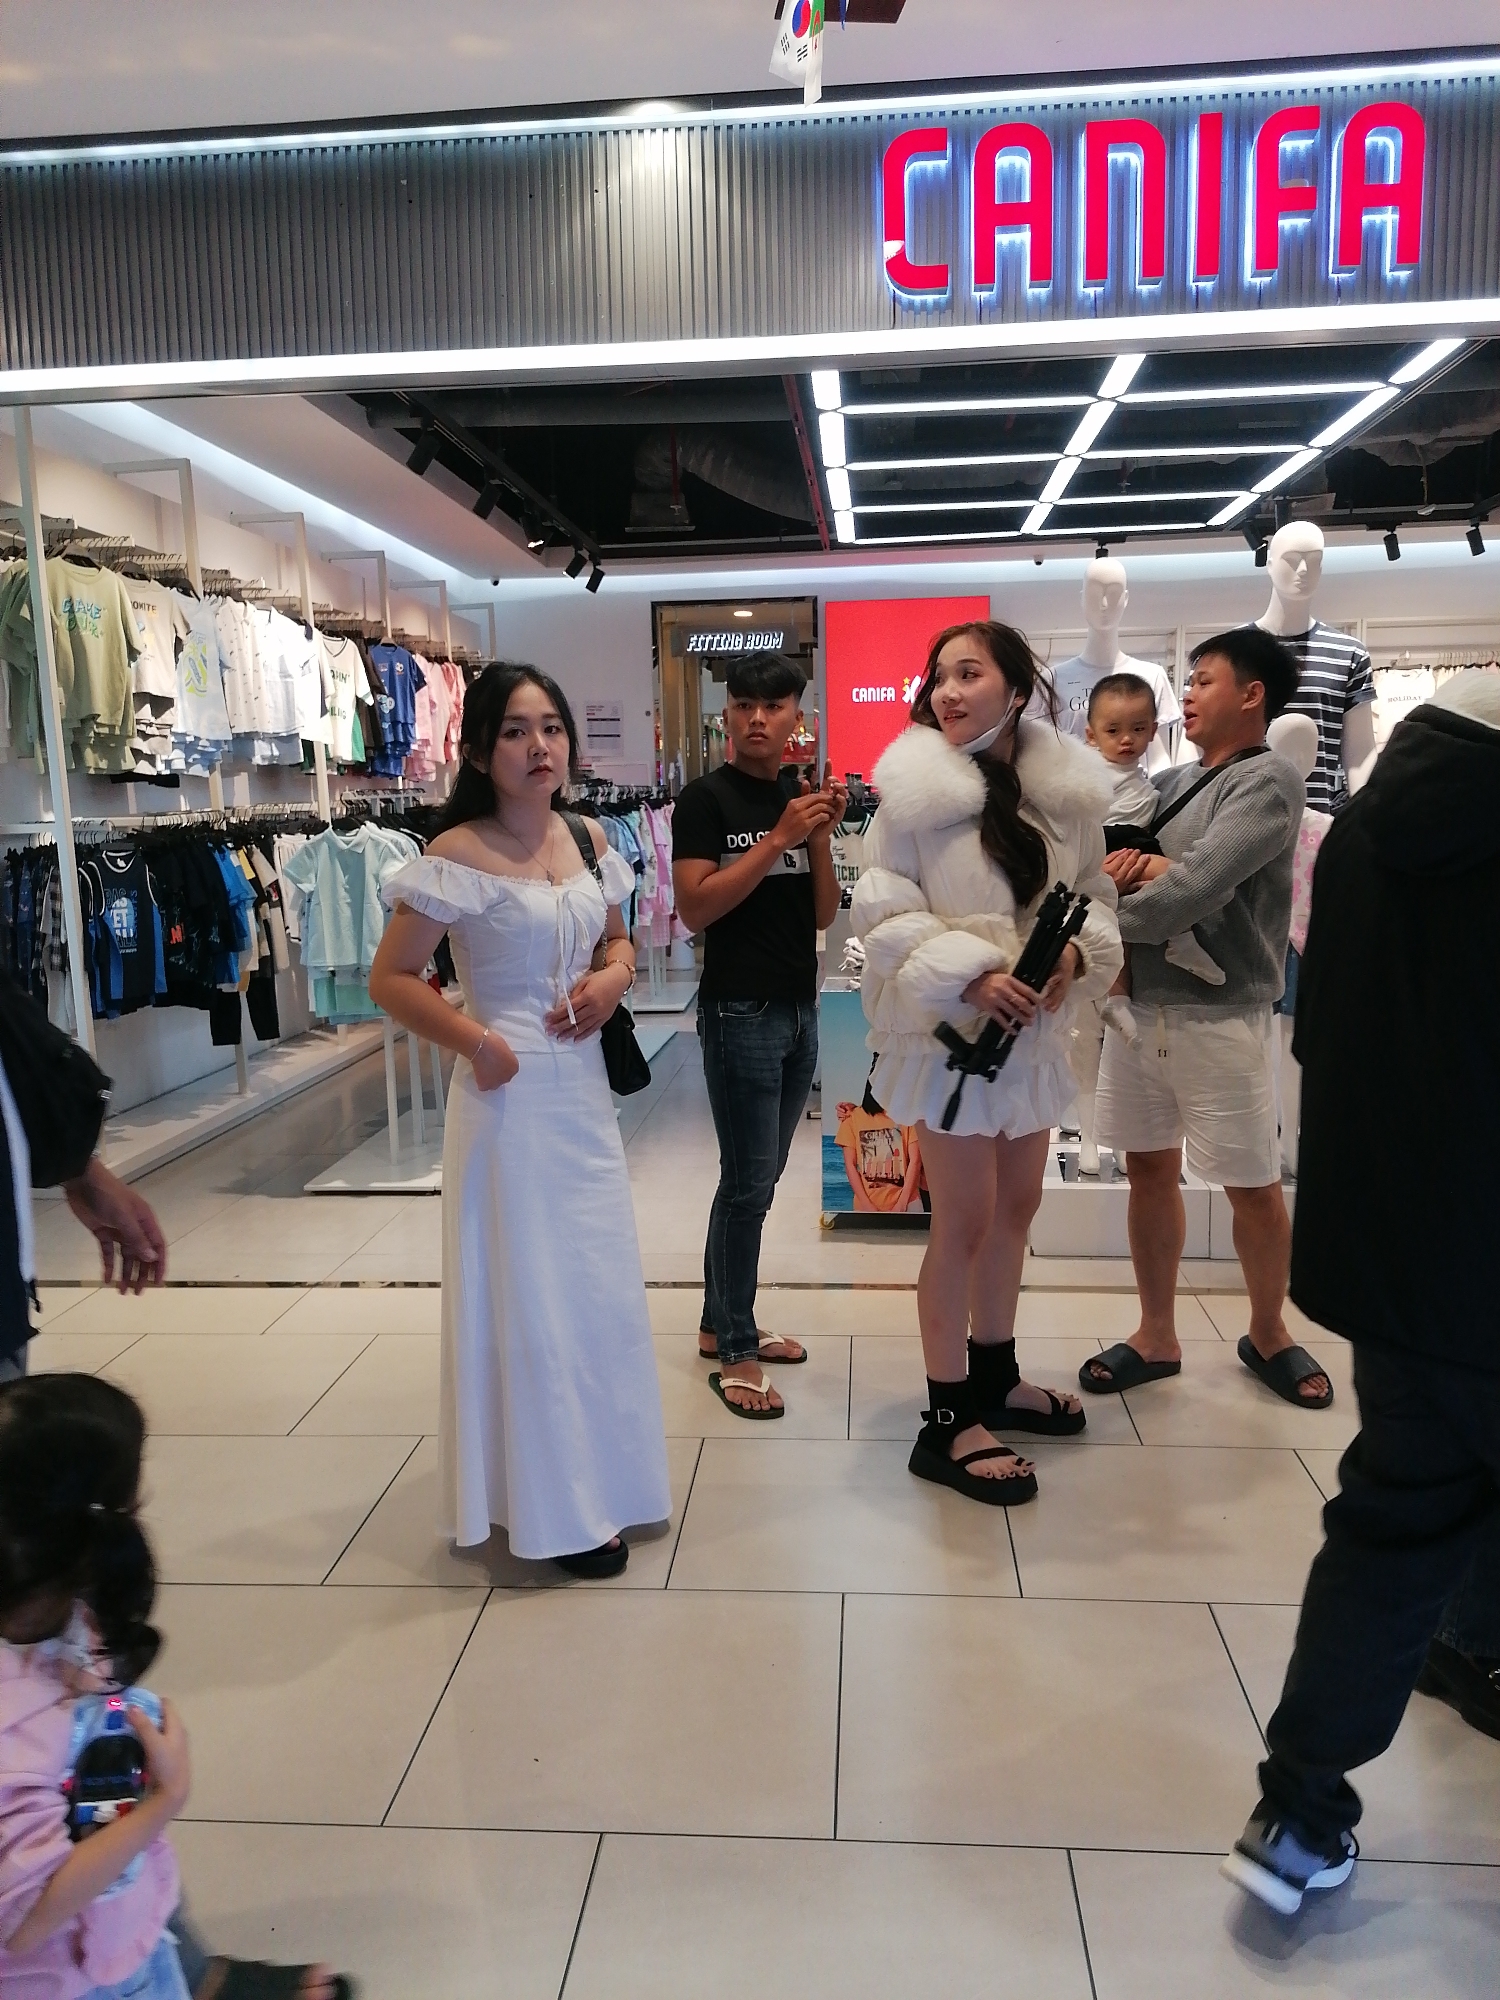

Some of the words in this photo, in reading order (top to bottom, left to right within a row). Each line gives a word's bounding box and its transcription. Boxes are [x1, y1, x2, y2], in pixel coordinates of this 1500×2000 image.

[883, 102, 1425, 291] CANIFA
[687, 632, 743, 652] FITTING
[744, 630, 784, 650] ROOM
[852, 687, 896, 703] CANIFA
[1387, 695, 1423, 703] HOLIDAY
[726, 830, 771, 849] DOLC
